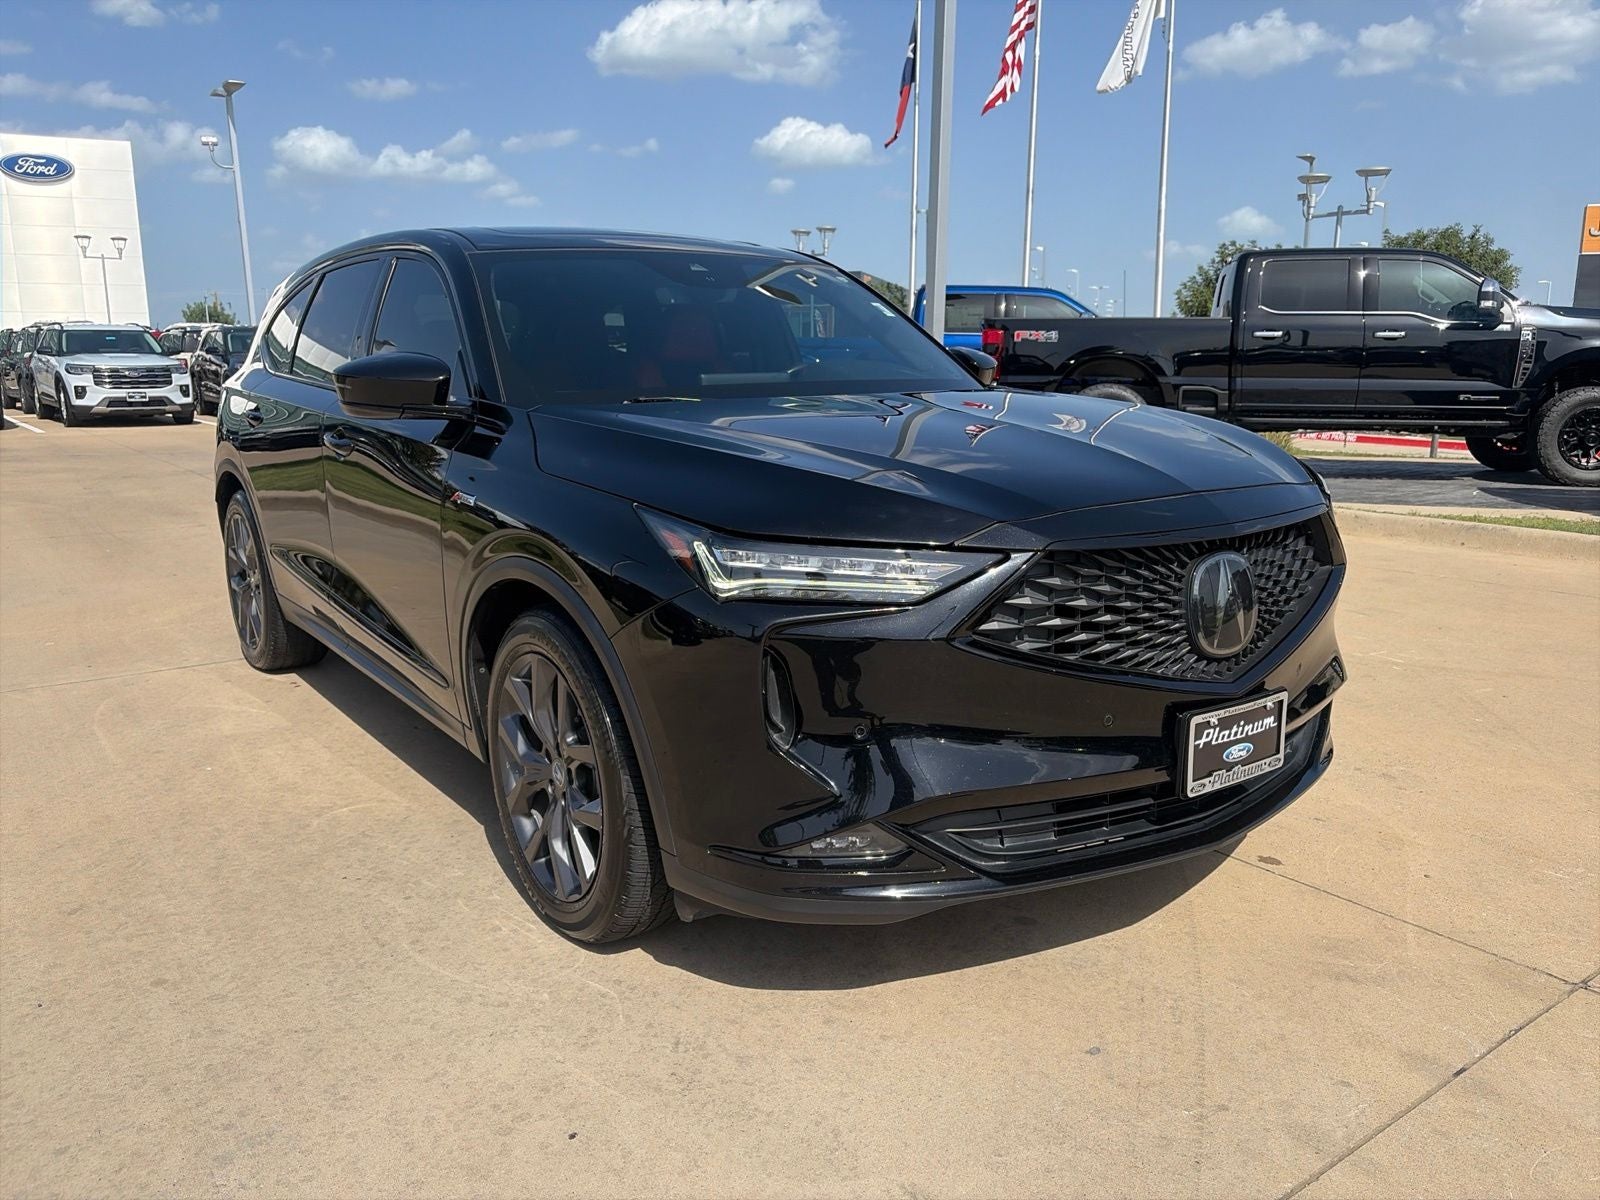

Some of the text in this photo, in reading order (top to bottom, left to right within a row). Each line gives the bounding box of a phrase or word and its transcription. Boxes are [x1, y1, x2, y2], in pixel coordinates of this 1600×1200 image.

[14, 156, 58, 175] Ford
[1013, 330, 1059, 342] FX4
[1194, 715, 1278, 749] Platinum
[1228, 745, 1249, 760] Ford
[1211, 764, 1264, 787] Platinum
